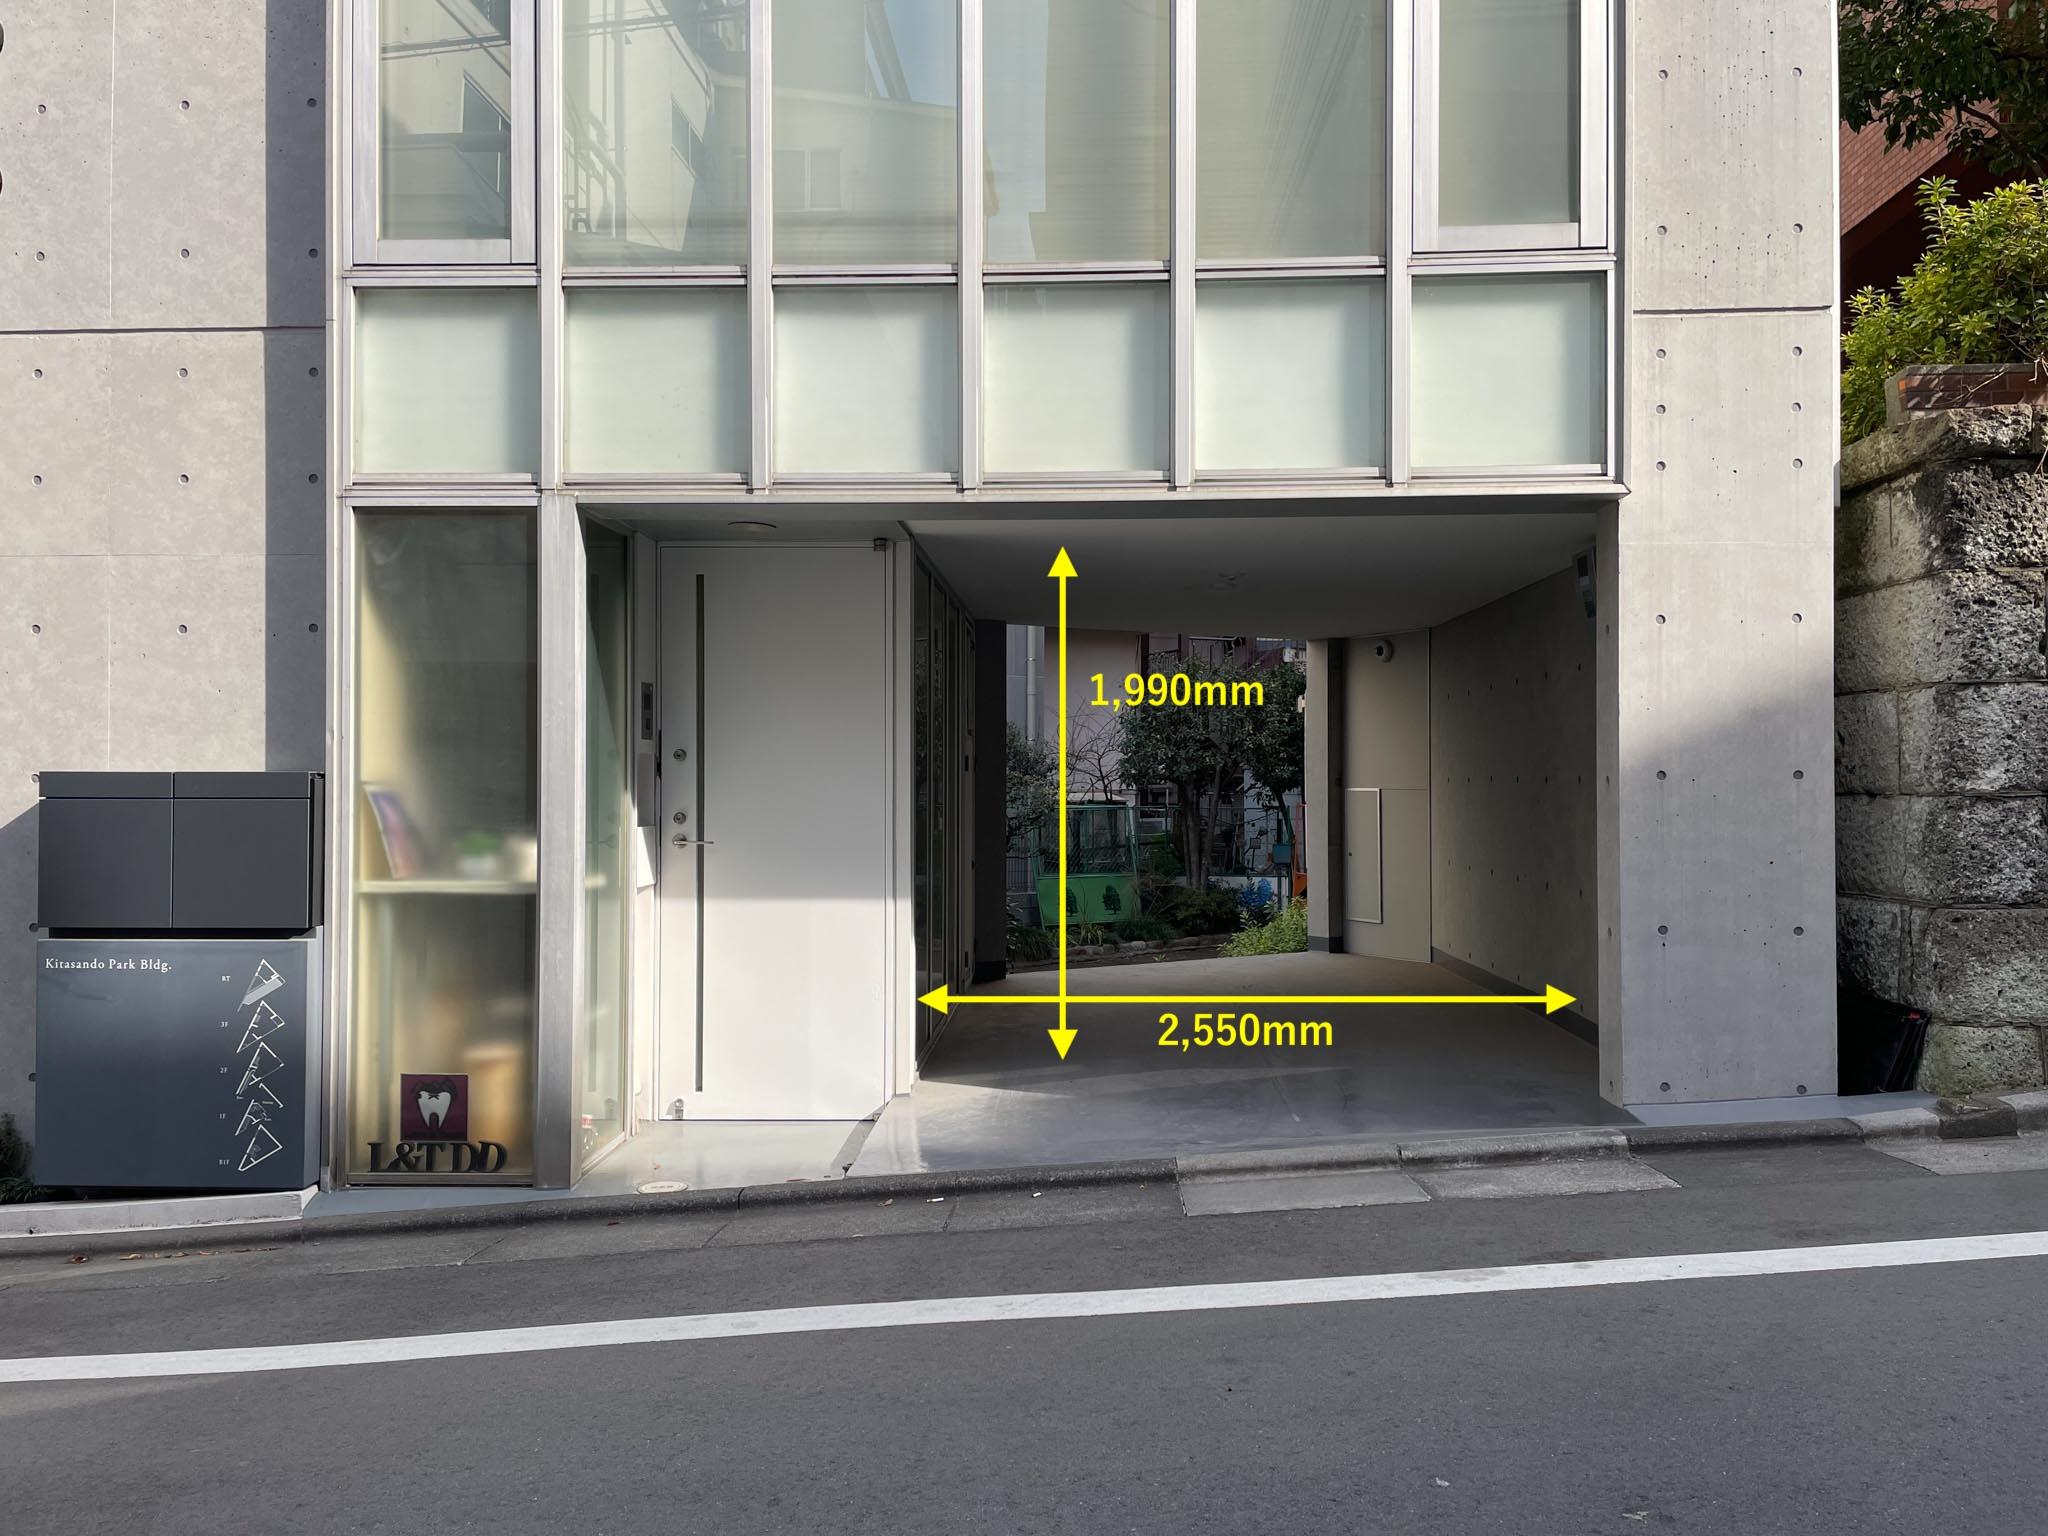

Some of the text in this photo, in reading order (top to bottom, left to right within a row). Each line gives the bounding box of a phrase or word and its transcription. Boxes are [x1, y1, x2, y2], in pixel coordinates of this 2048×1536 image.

[45, 958, 172, 973] Kitasando Park Bldg.
